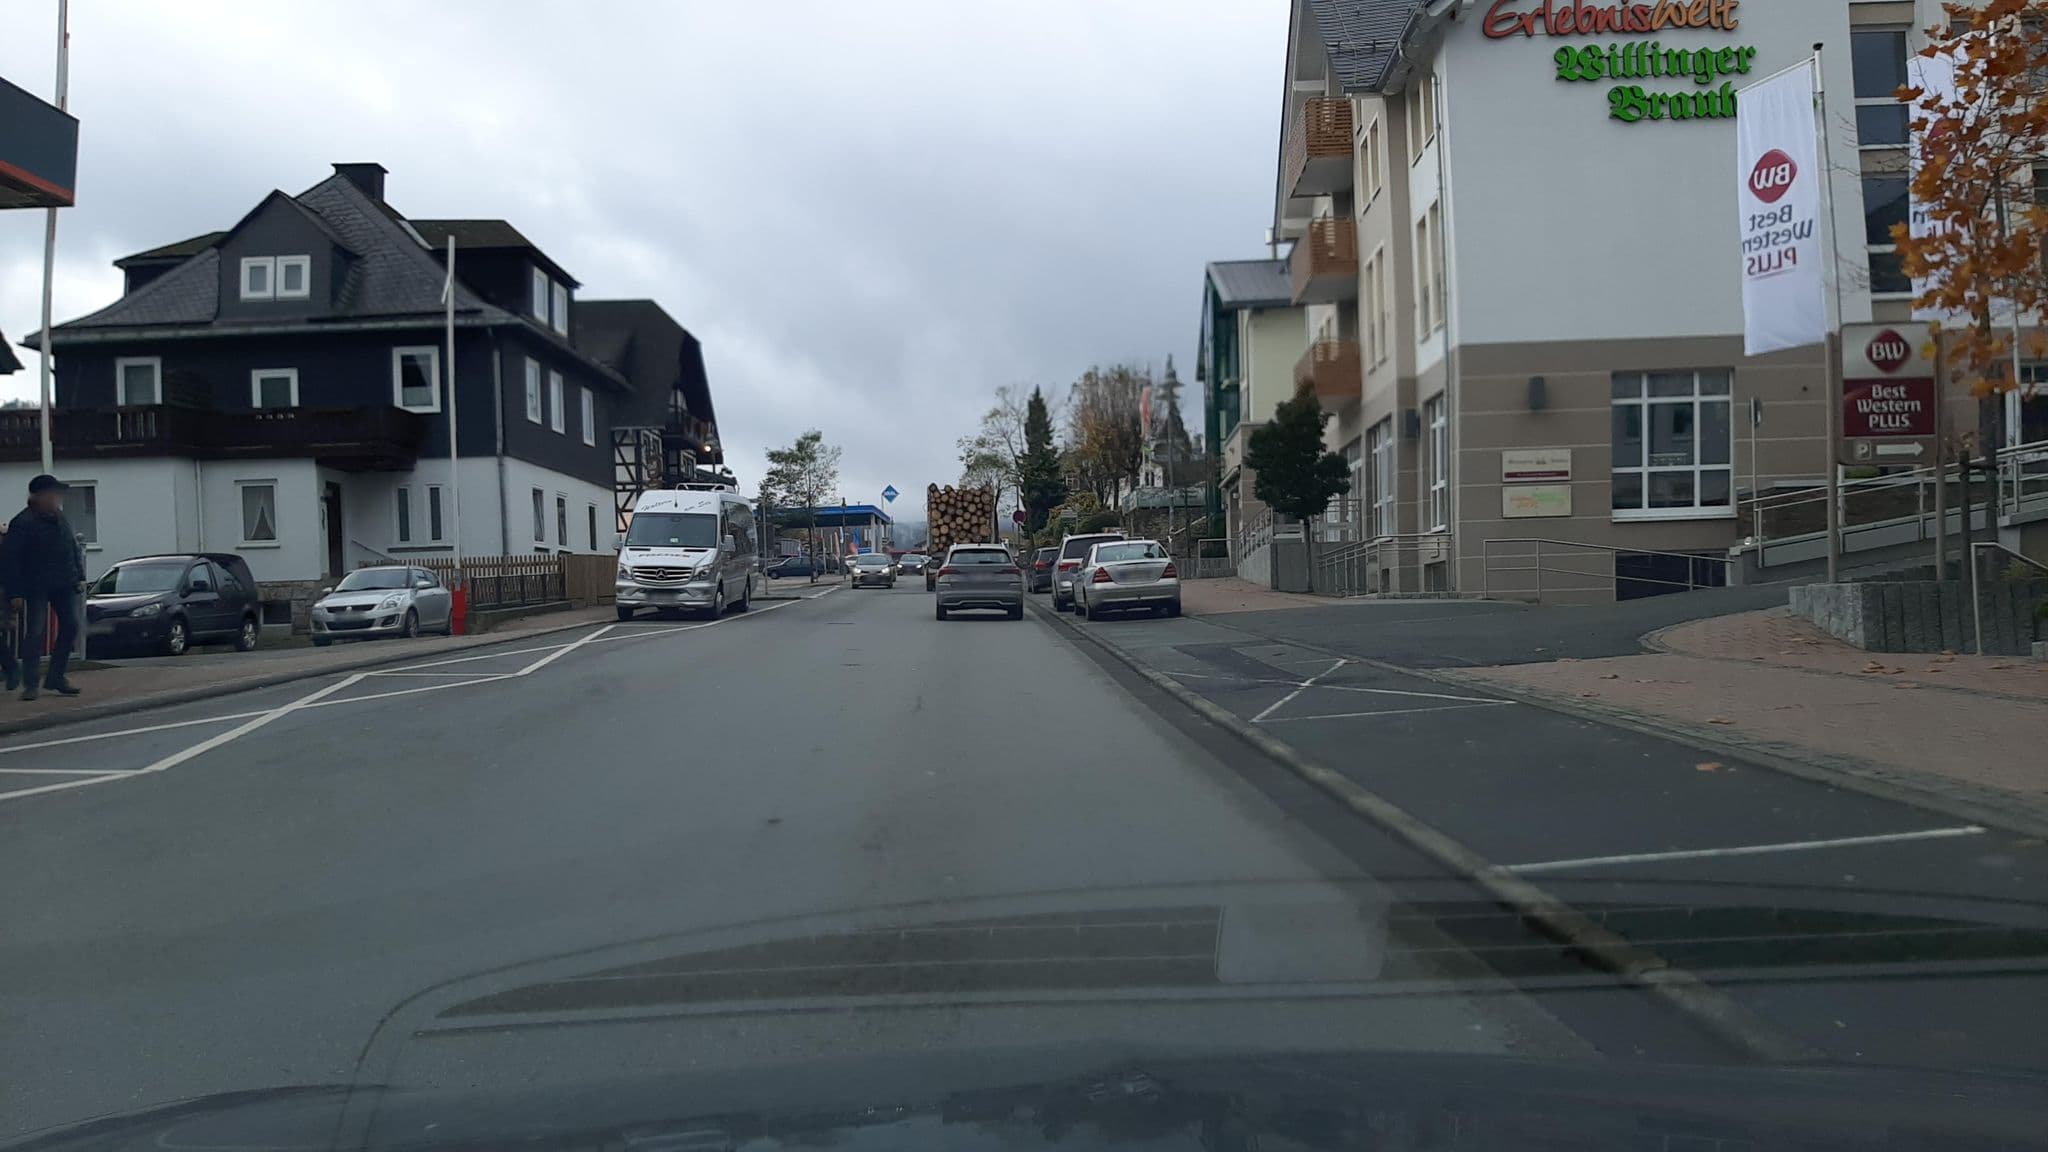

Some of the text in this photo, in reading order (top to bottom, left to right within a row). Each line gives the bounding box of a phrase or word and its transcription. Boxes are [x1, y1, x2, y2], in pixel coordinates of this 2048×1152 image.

[1553, 41, 1757, 84] Willinger
[1607, 81, 1738, 122] Brauh
[1871, 341, 1905, 360] BW
[1871, 384, 1906, 399] Best
[1856, 399, 1921, 413] Western
[1868, 413, 1911, 429] PLUS
